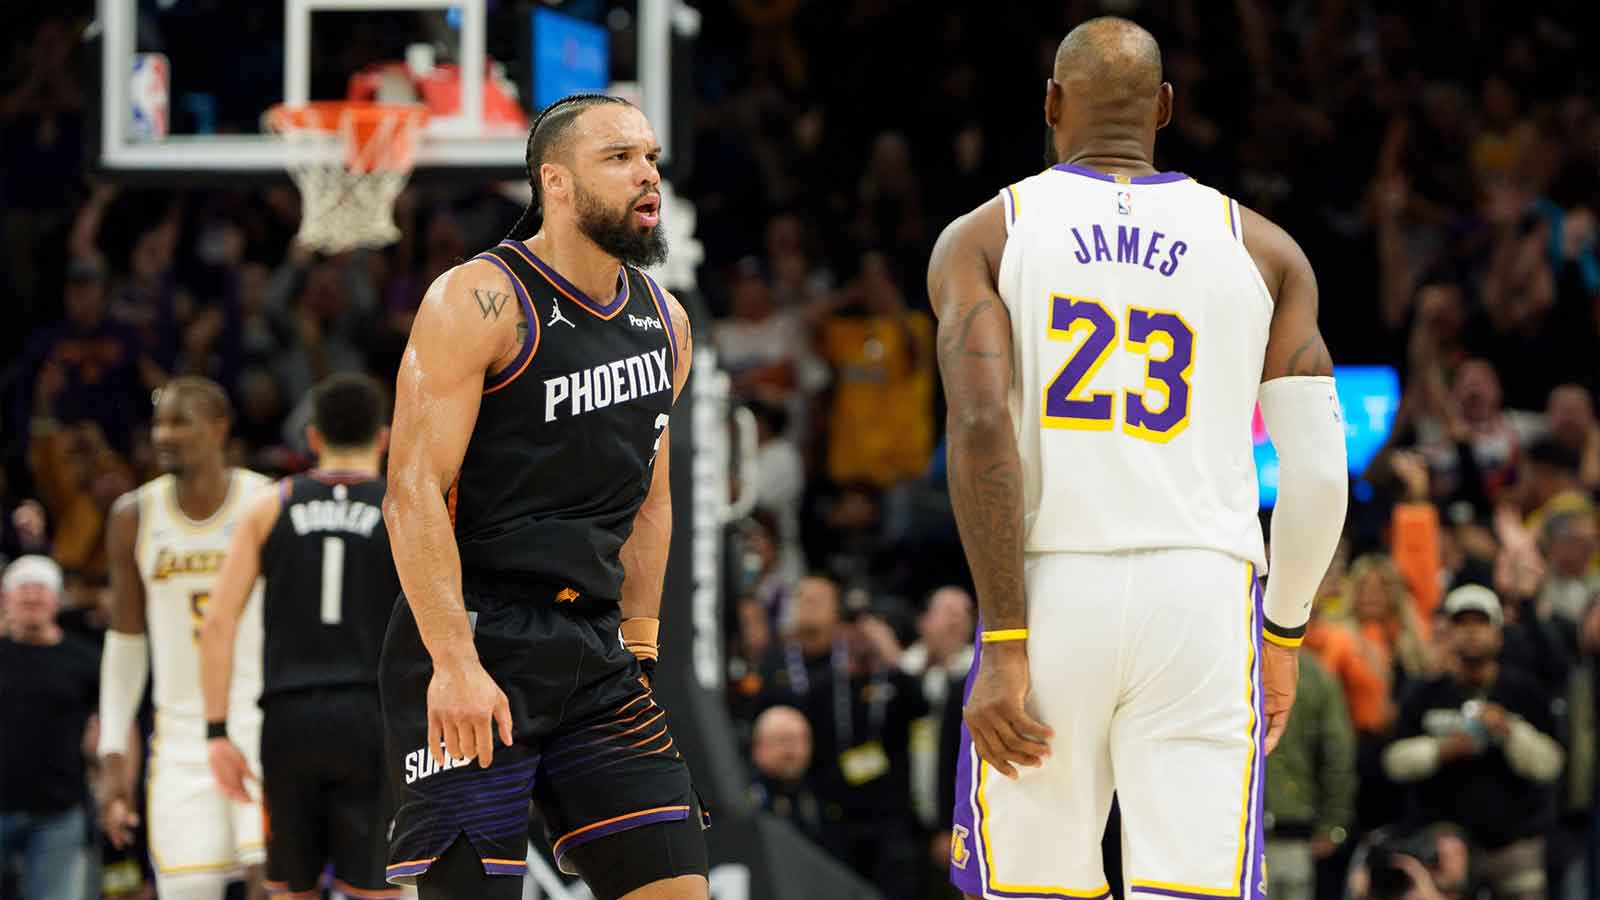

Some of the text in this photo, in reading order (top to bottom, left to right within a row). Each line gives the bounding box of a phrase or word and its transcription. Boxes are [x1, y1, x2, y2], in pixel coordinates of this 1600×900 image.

[1071, 224, 1188, 277] JAMES
[543, 348, 672, 423] PHOENIX
[1040, 292, 1198, 444] 23
[320, 536, 345, 625] 1
